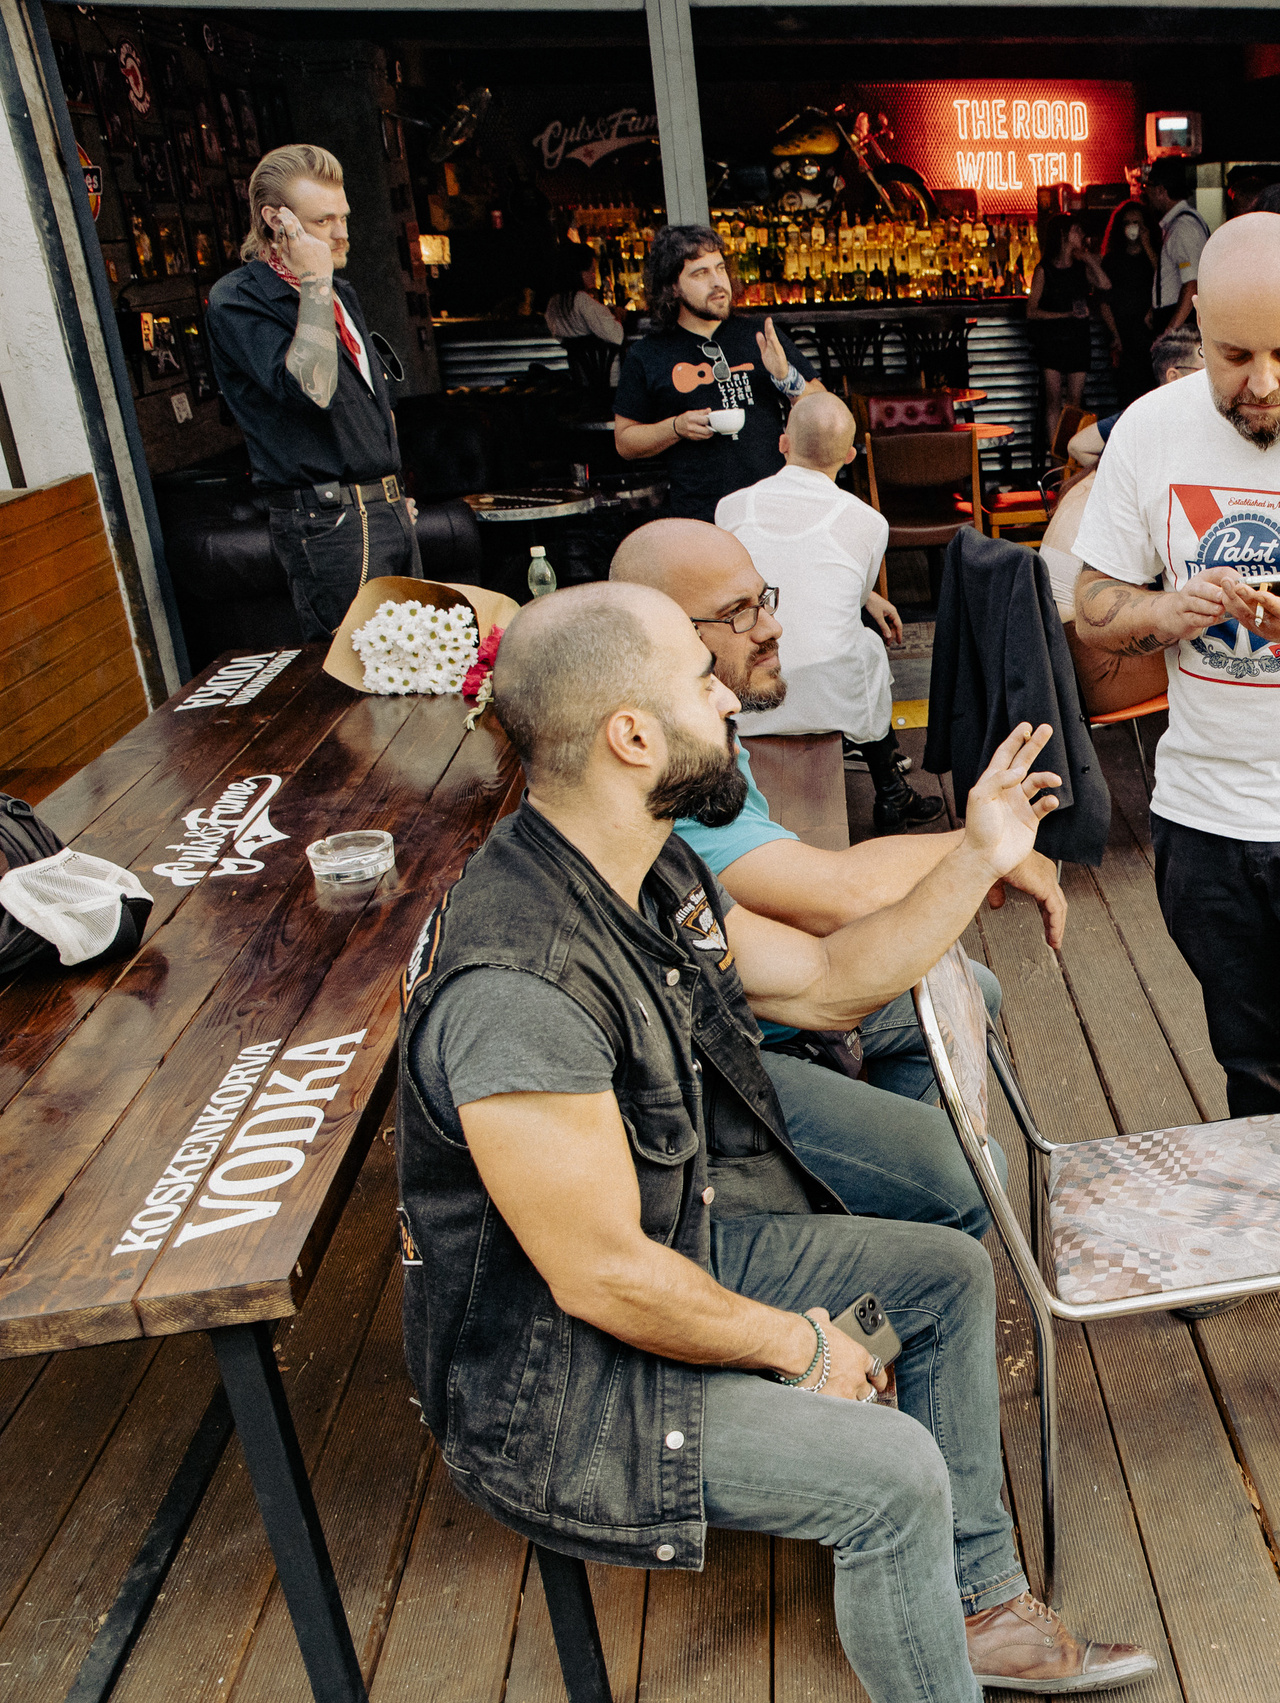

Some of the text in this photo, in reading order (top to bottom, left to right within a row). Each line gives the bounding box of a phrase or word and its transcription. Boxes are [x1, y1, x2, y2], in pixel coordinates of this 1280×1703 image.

[532, 108, 660, 170] Guts&Fam
[953, 100, 1088, 141] THE ROAD
[956, 151, 1083, 193] WILL TELL
[1228, 497, 1266, 508] Established
[1266, 501, 1275, 509] in
[1213, 527, 1279, 564] Pabst
[173, 651, 278, 712] VODKA
[152, 773, 282, 887] Guts&Fame
[111, 1038, 282, 1257] KOSKENKORVA
[173, 1028, 368, 1248] VODKA
